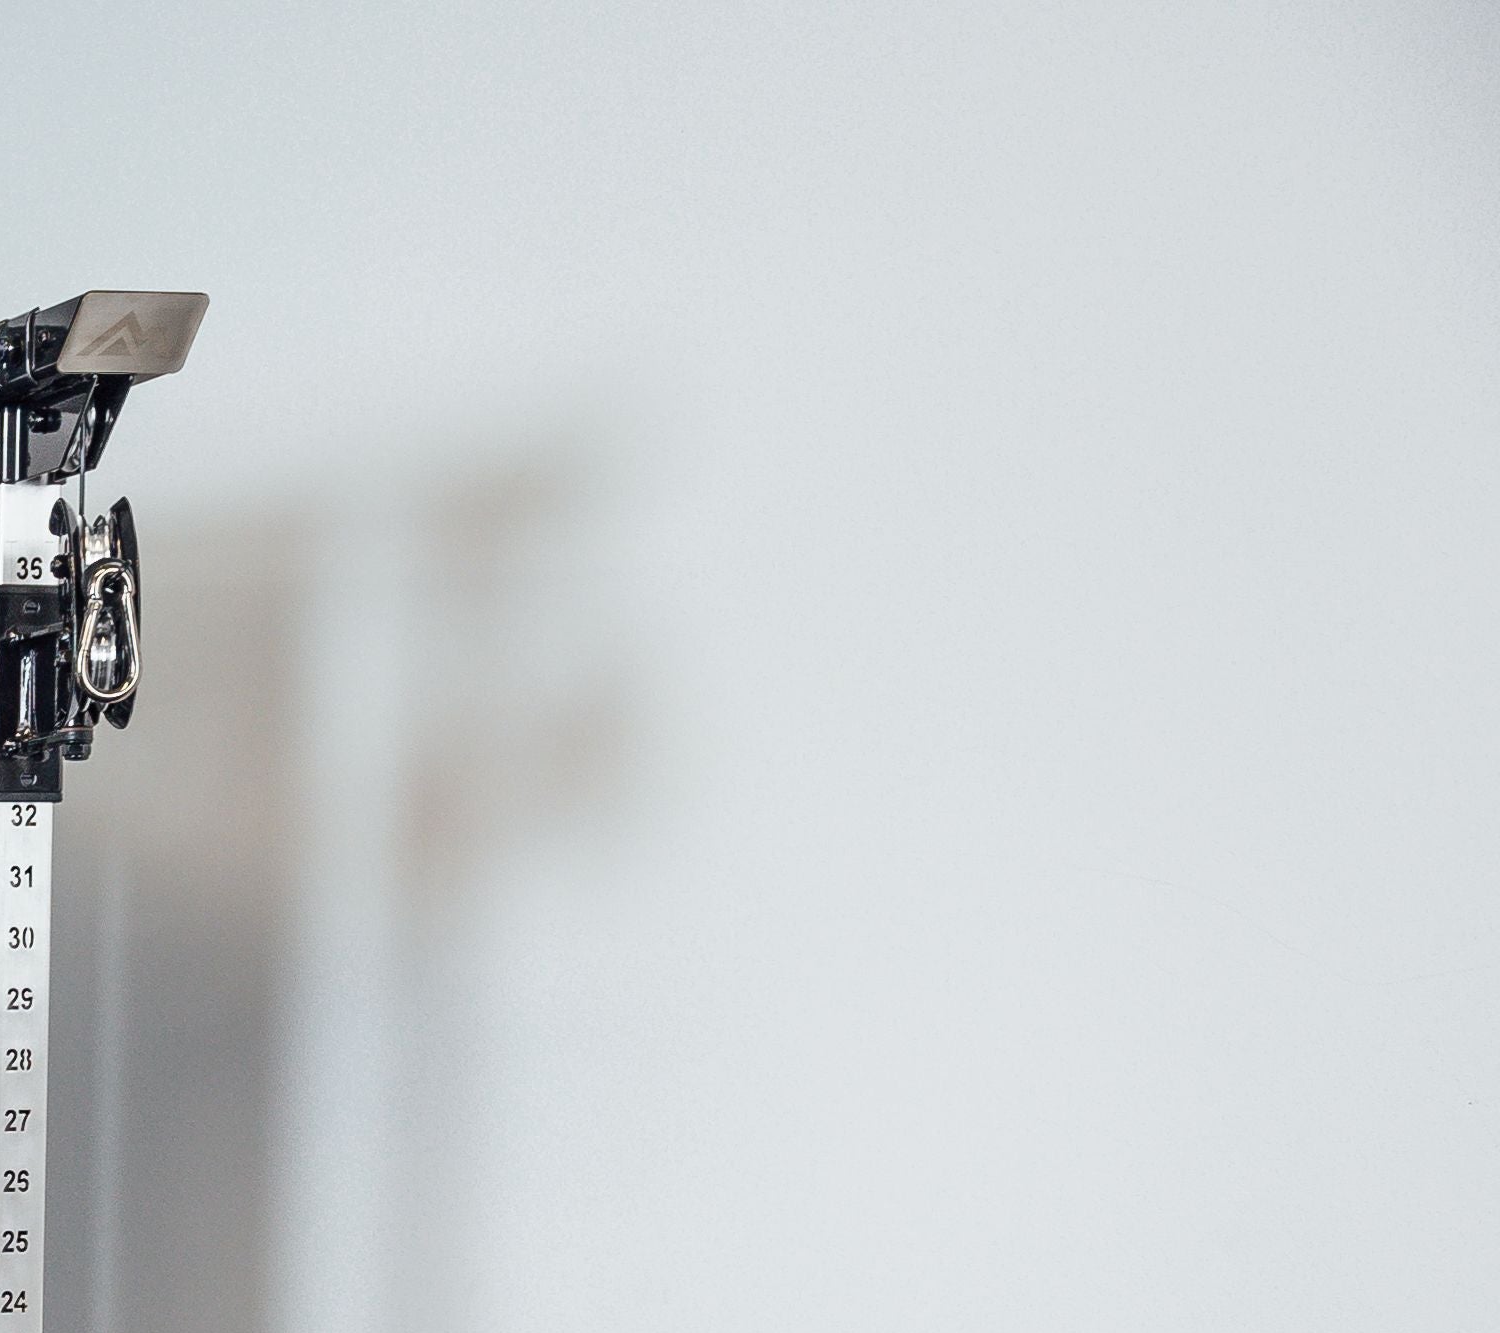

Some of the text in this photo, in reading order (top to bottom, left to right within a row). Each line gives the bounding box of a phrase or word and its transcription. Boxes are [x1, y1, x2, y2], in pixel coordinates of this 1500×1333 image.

[10, 803, 37, 828] 32
[10, 865, 33, 888] 31
[8, 926, 35, 950] 30
[5, 1048, 32, 1071] 28
[4, 1109, 31, 1132] 27
[1, 1230, 29, 1253] 25
[0, 1290, 28, 1314] 24
